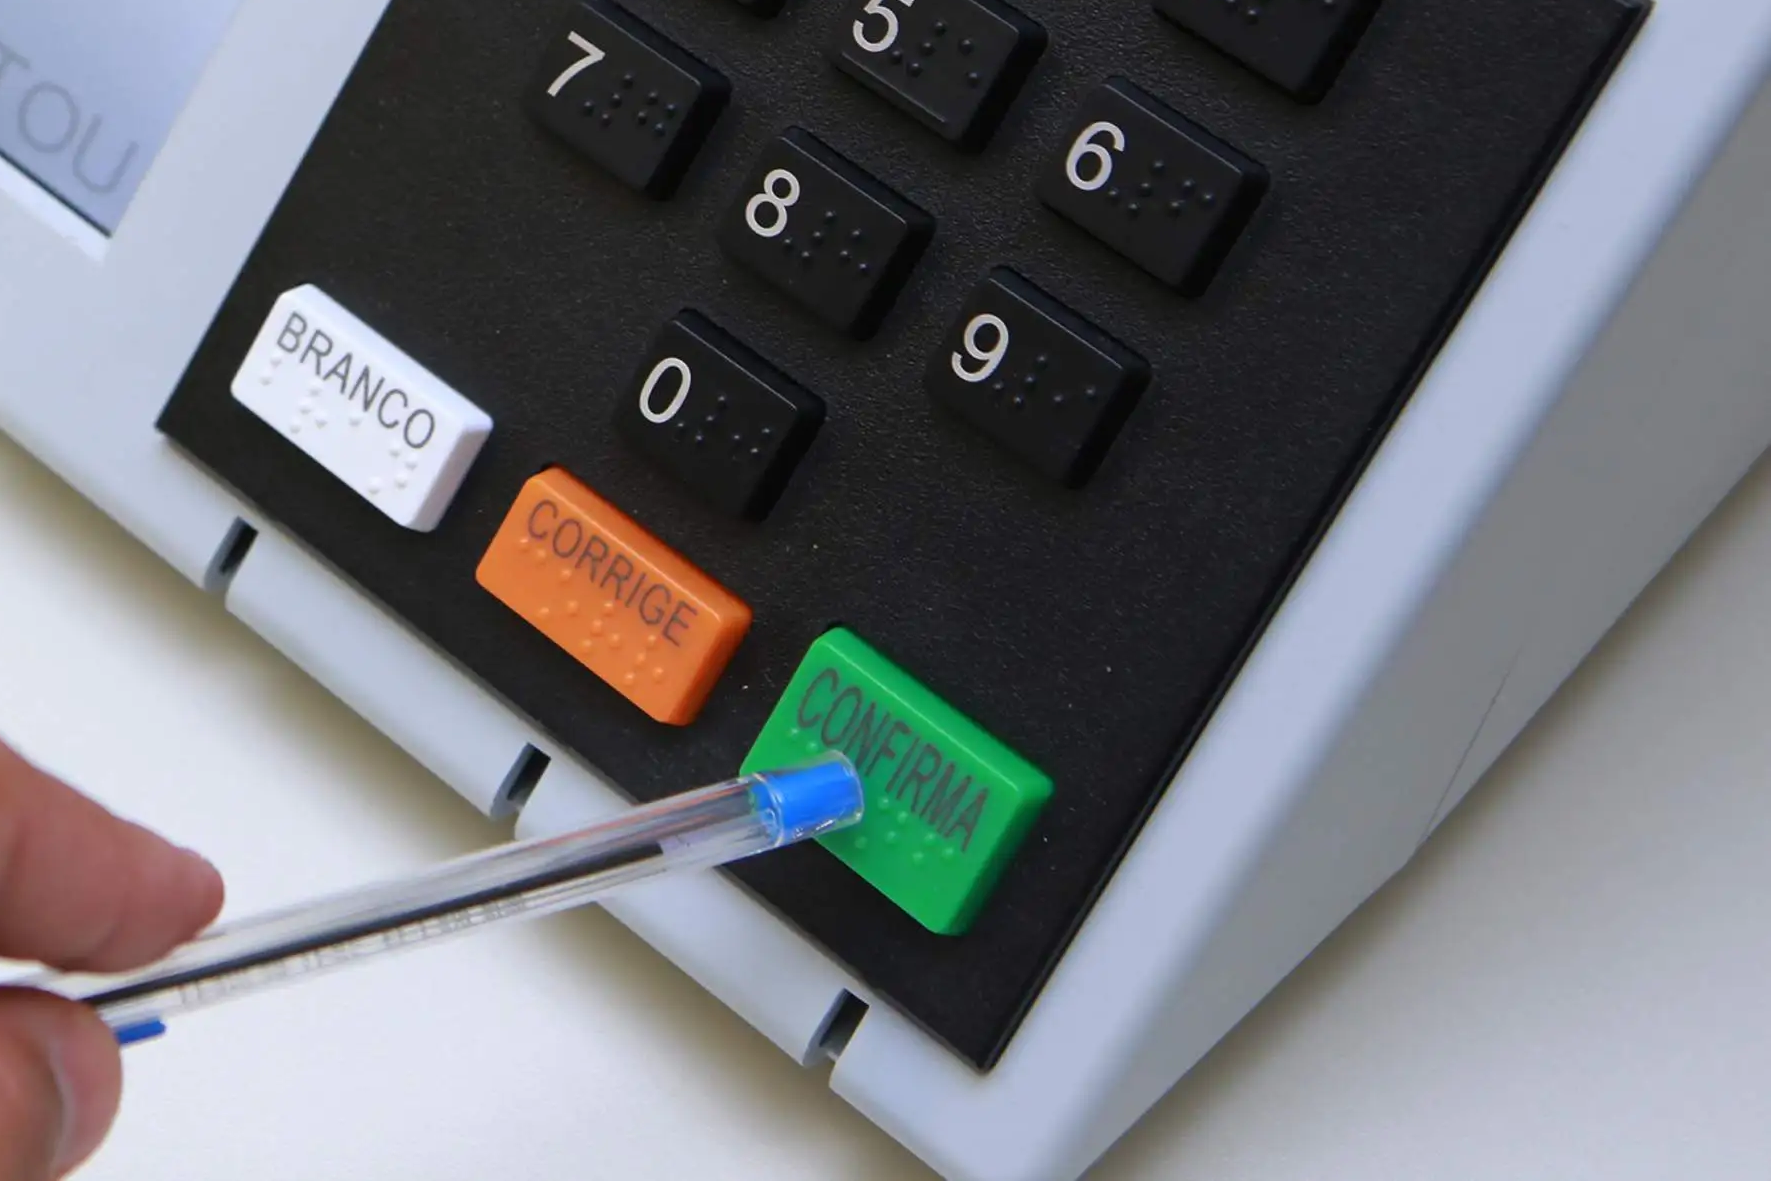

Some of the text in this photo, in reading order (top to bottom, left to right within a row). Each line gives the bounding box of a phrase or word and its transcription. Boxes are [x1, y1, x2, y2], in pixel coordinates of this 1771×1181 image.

[546, 30, 606, 98] 7
[1065, 120, 1126, 191] 6
[744, 168, 802, 238] 8
[276, 311, 436, 451] BRANCO
[950, 312, 1010, 383] 9
[638, 356, 693, 424] 0
[527, 498, 698, 647] CORRIGE
[796, 667, 992, 853] CONFIRMA
